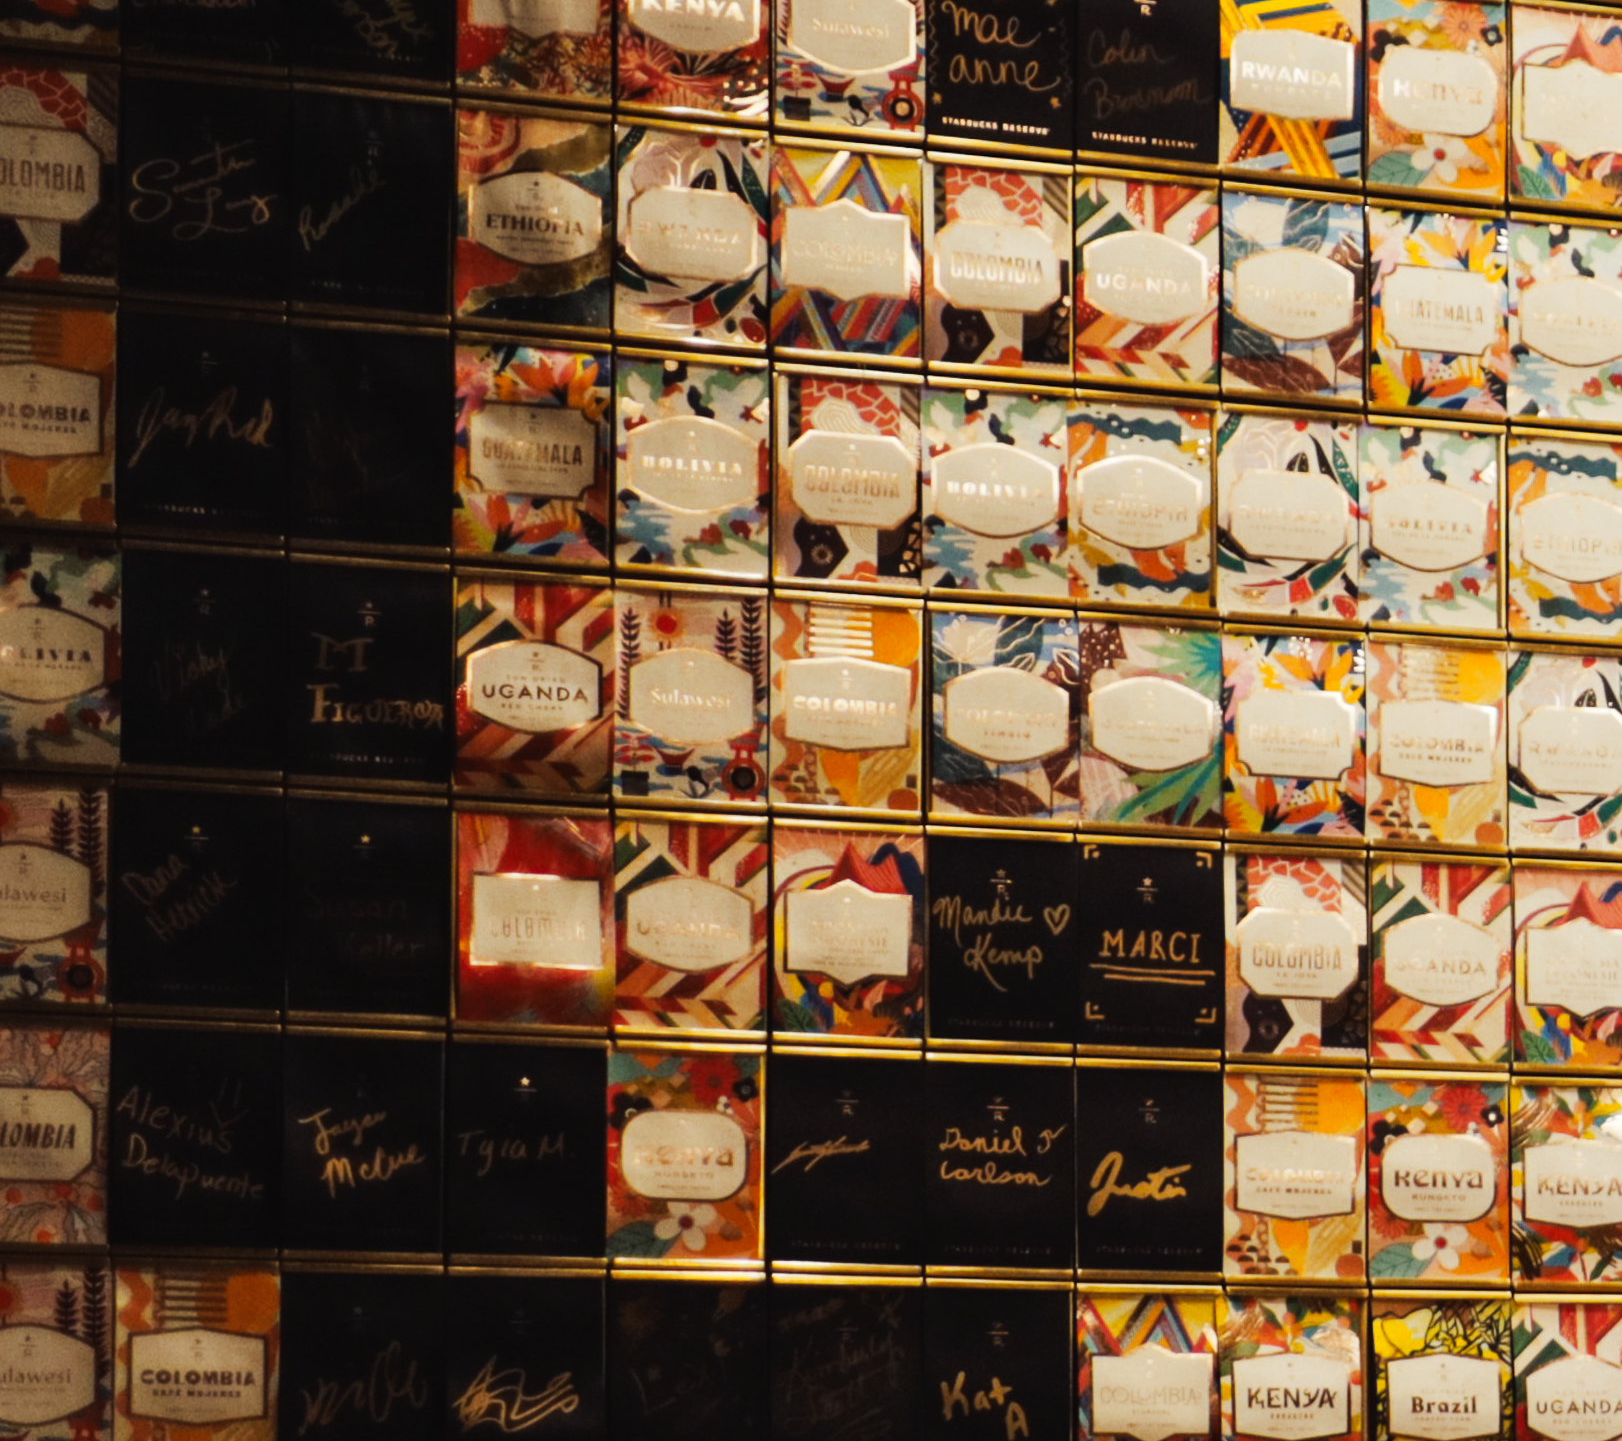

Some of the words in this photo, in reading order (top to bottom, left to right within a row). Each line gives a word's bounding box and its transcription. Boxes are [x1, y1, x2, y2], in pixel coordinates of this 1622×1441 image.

[942, 117, 998, 130] STARBUCKS
[1002, 123, 1049, 135] RESERVE
[482, 684, 587, 708] UGANDA
[1100, 929, 1200, 963] MARCI
[1394, 1171, 1482, 1189] Kenya
[141, 1370, 255, 1386] COLOMBIA
[1248, 1389, 1335, 1408] KENYA
[1412, 1397, 1476, 1414] Brazil
